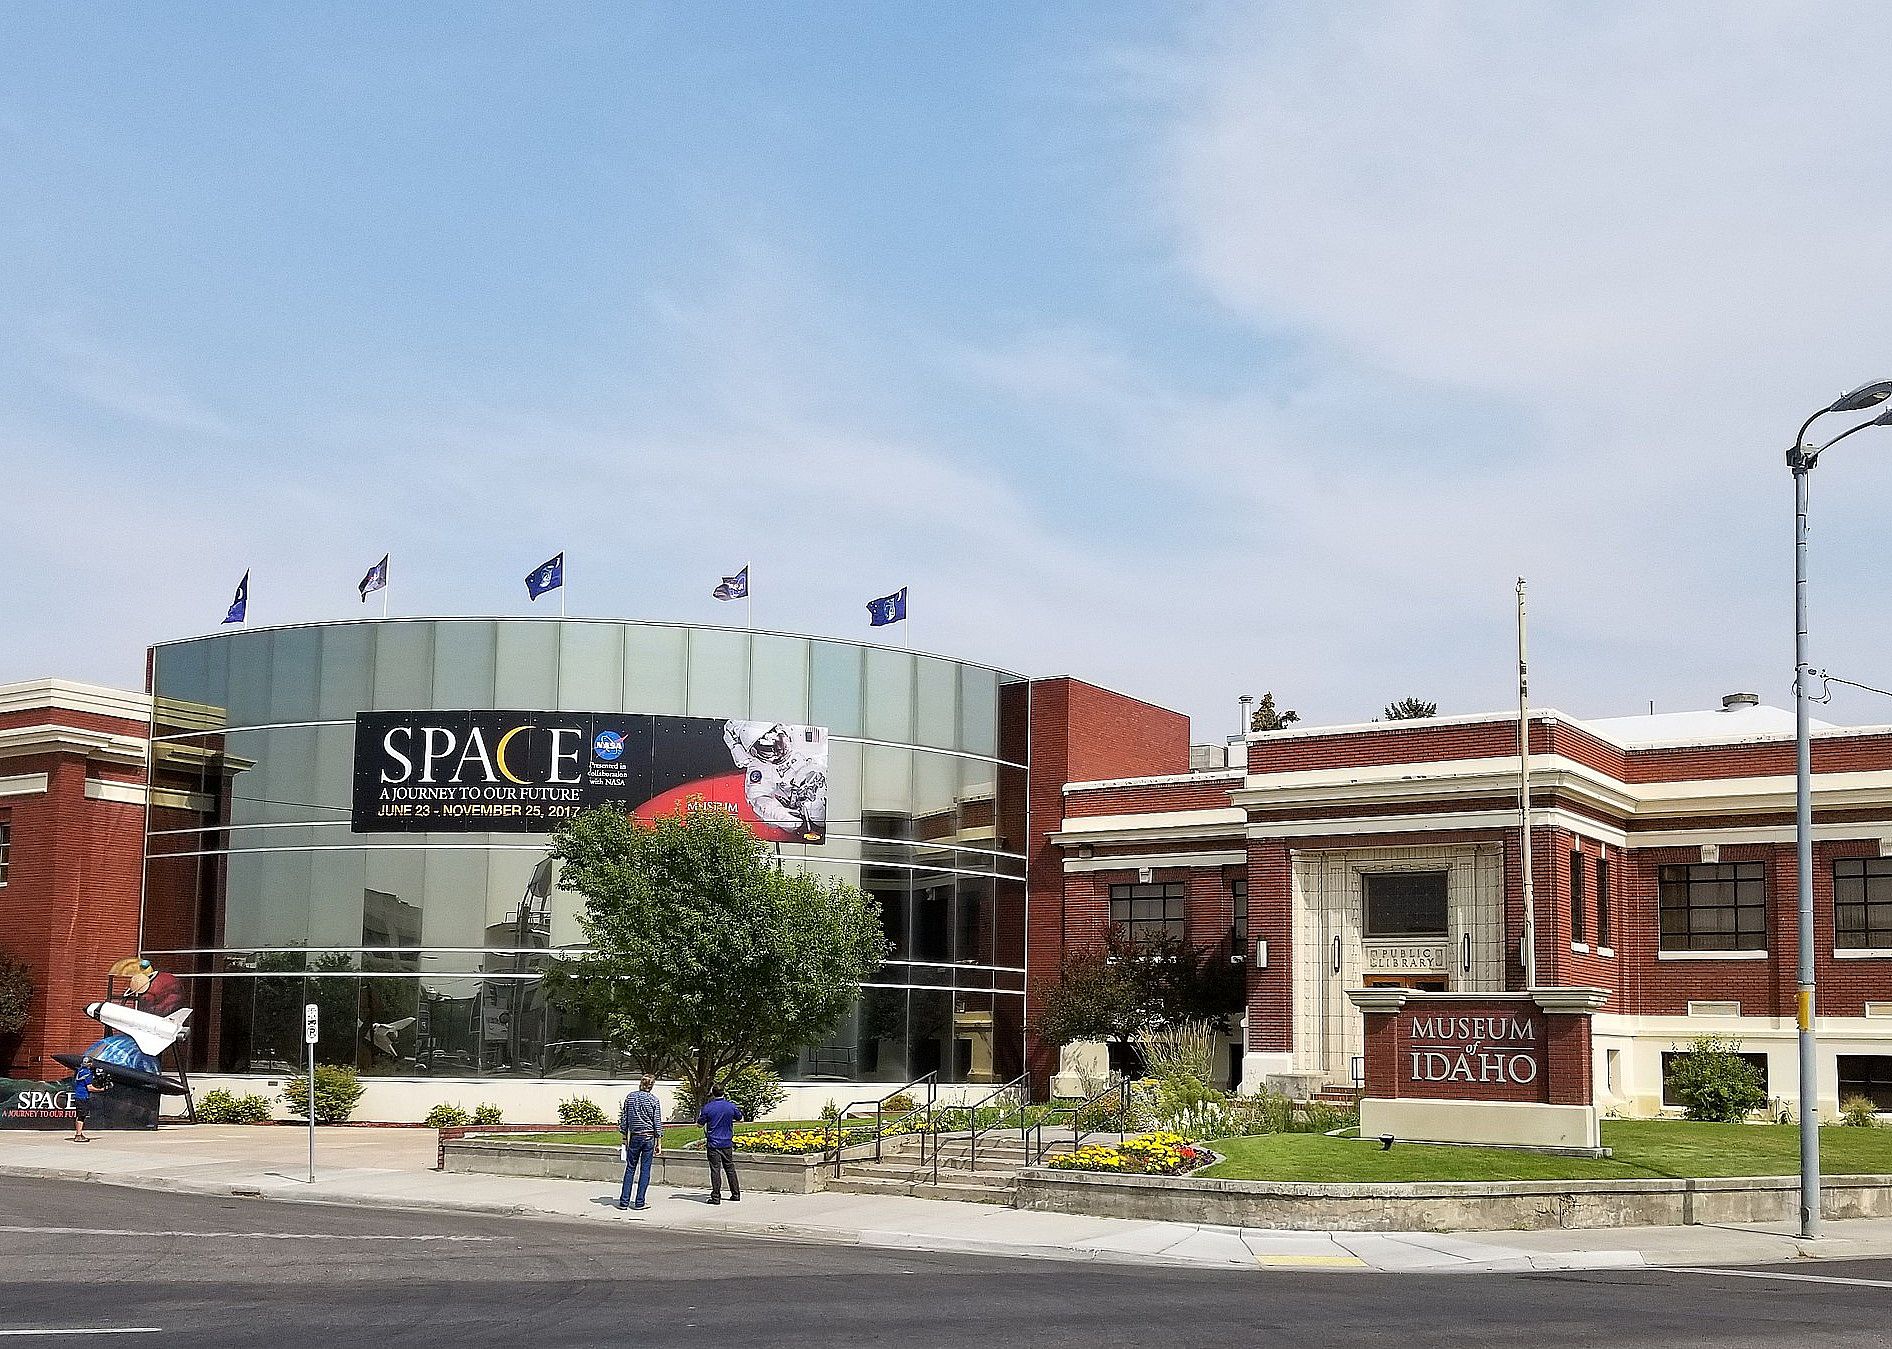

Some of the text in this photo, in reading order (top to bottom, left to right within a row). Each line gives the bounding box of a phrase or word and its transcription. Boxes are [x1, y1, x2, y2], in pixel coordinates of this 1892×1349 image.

[596, 741, 622, 750] NASA
[380, 725, 583, 785] SPACE
[589, 777, 626, 786] with NASA
[379, 787, 390, 800] A
[391, 786, 458, 802] JOURNEY
[458, 786, 481, 800] TO
[483, 786, 517, 800] OUR
[377, 804, 413, 817] JUNE
[414, 804, 431, 817] 23
[442, 804, 522, 818] NOVEMBER
[525, 805, 545, 819] 25,
[547, 806, 581, 818] 2017
[1382, 948, 1432, 959] PUBLIC
[1378, 957, 1435, 968] LIBRARY
[1409, 1016, 1536, 1041] MUSEUM
[1465, 1041, 1481, 1056] of
[1410, 1051, 1538, 1084] IDAHO
[17, 1090, 77, 1110] SPACE
[7, 1109, 39, 1118] JOURNEY
[40, 1110, 49, 1118] TO
[49, 1110, 64, 1118] OUR
